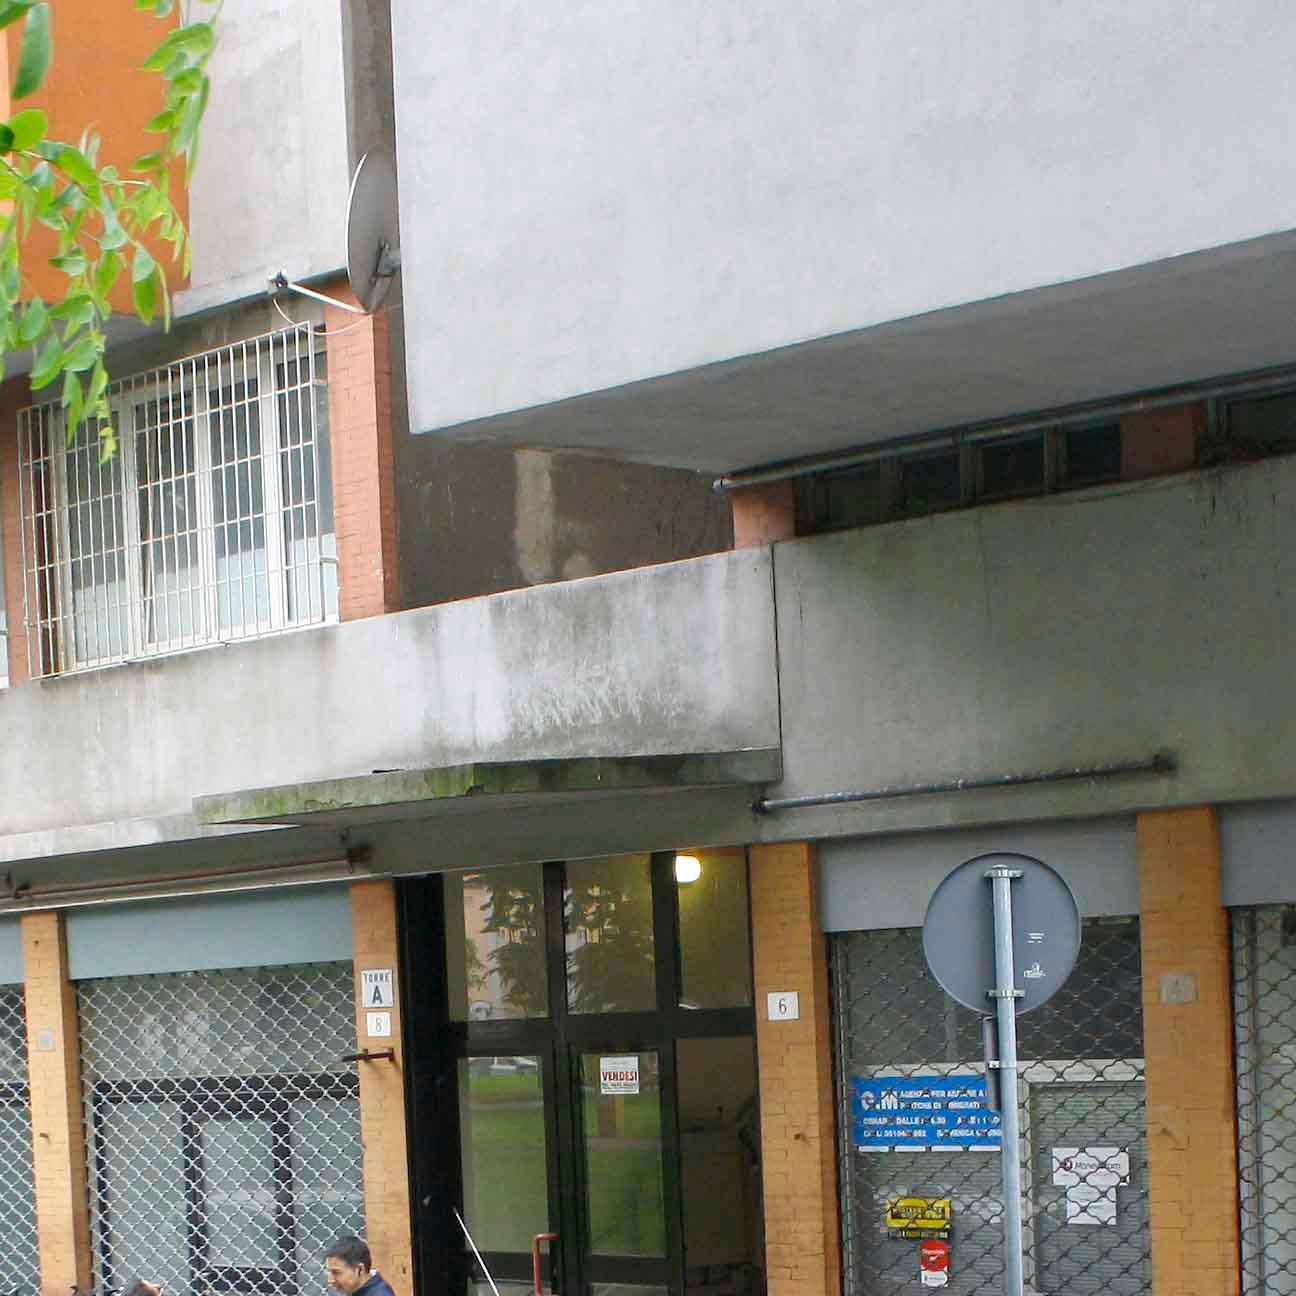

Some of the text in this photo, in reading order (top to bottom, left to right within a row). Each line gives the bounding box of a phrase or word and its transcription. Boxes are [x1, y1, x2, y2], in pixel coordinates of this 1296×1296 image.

[372, 985, 383, 1004] A
[778, 998, 787, 1015] 6
[375, 1016, 382, 1033] 8
[602, 1071, 638, 1081] VENDESI
